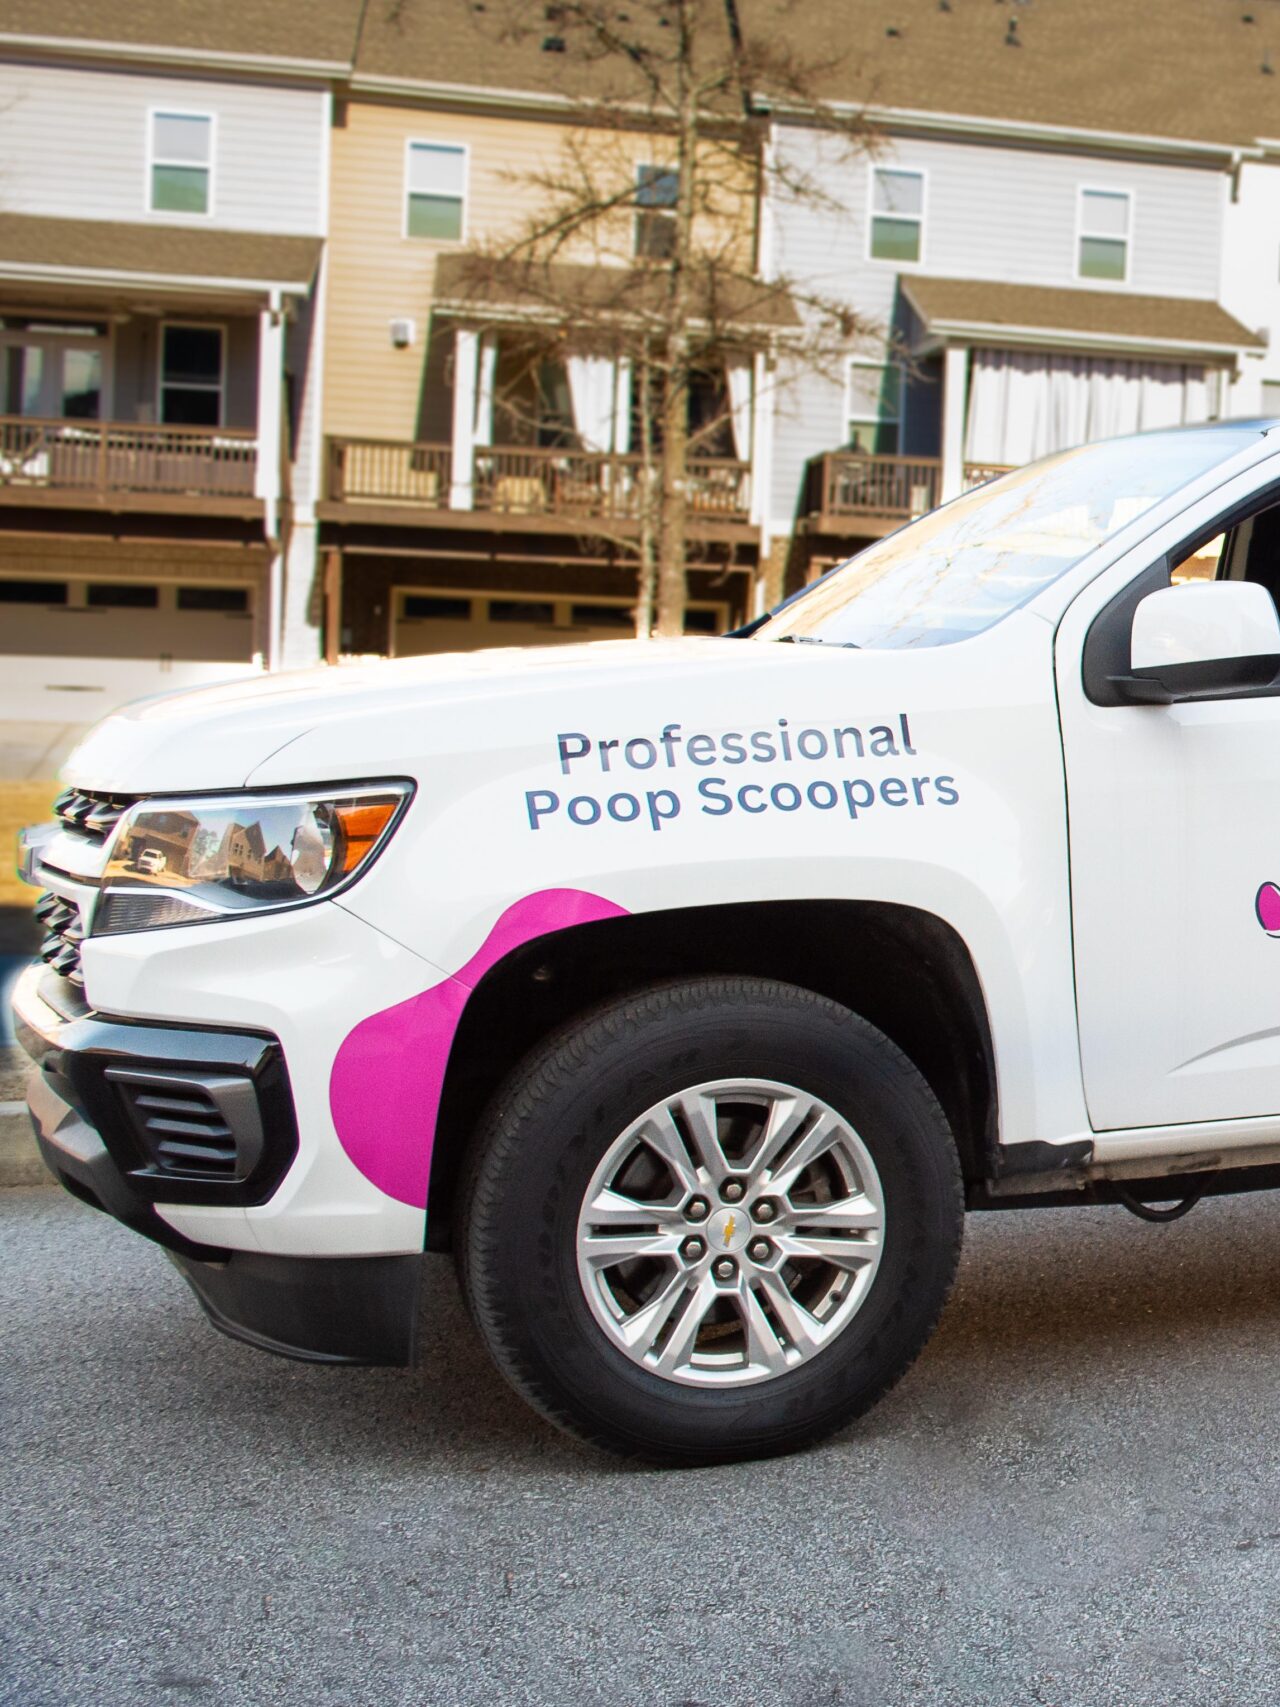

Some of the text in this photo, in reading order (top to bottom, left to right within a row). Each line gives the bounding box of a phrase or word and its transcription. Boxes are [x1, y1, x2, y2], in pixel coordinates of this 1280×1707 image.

[557, 713, 917, 775] Professional
[525, 773, 960, 831] Poop Scoopers
